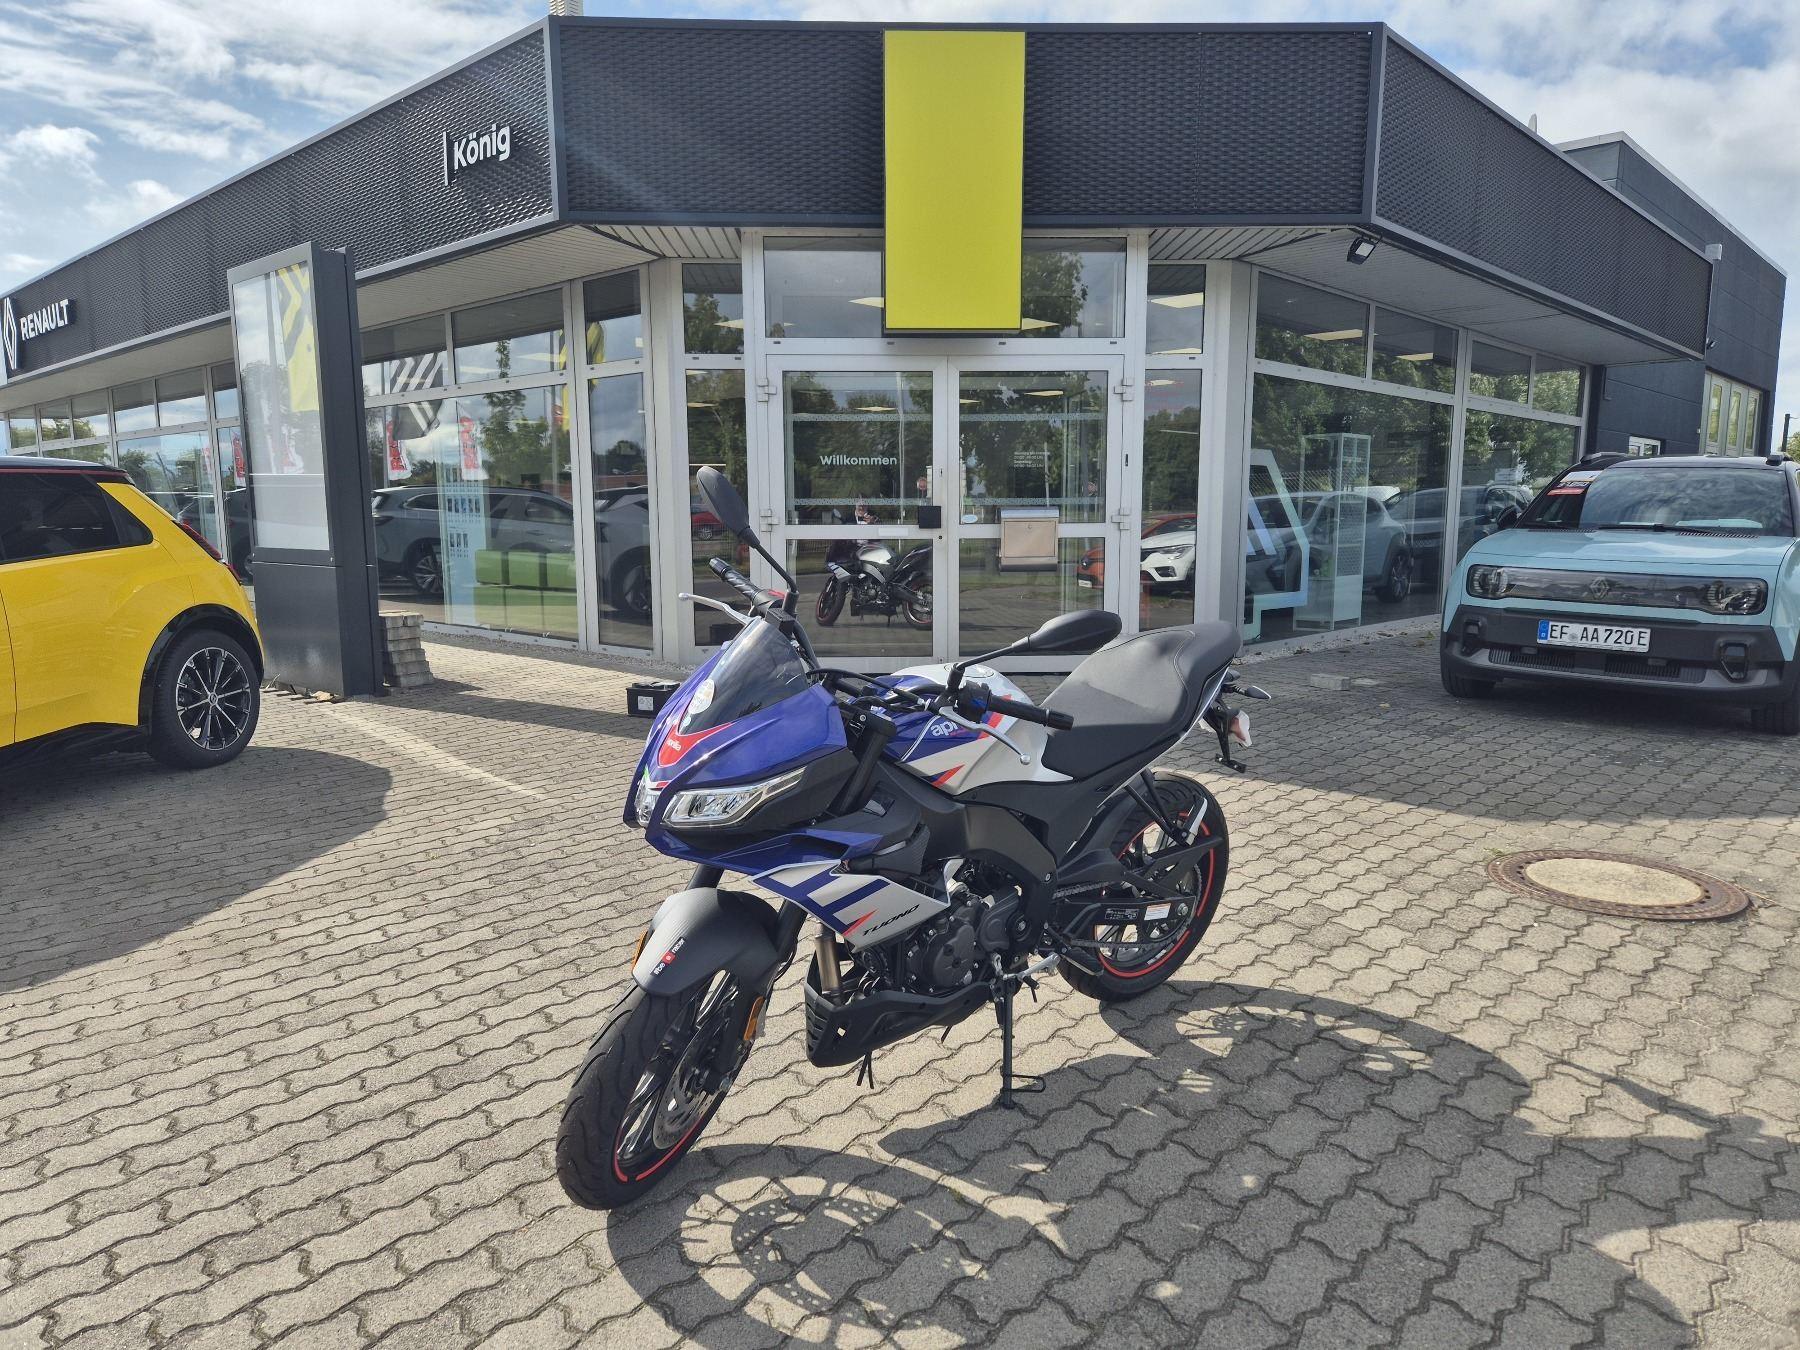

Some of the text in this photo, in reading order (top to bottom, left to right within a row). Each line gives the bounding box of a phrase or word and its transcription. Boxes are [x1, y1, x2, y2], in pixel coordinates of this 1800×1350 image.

[453, 123, 511, 170] König
[20, 298, 69, 341] RENAULT
[819, 454, 898, 466] Willkommen
[1549, 624, 1570, 640] EF
[862, 903, 921, 937] TUONO
